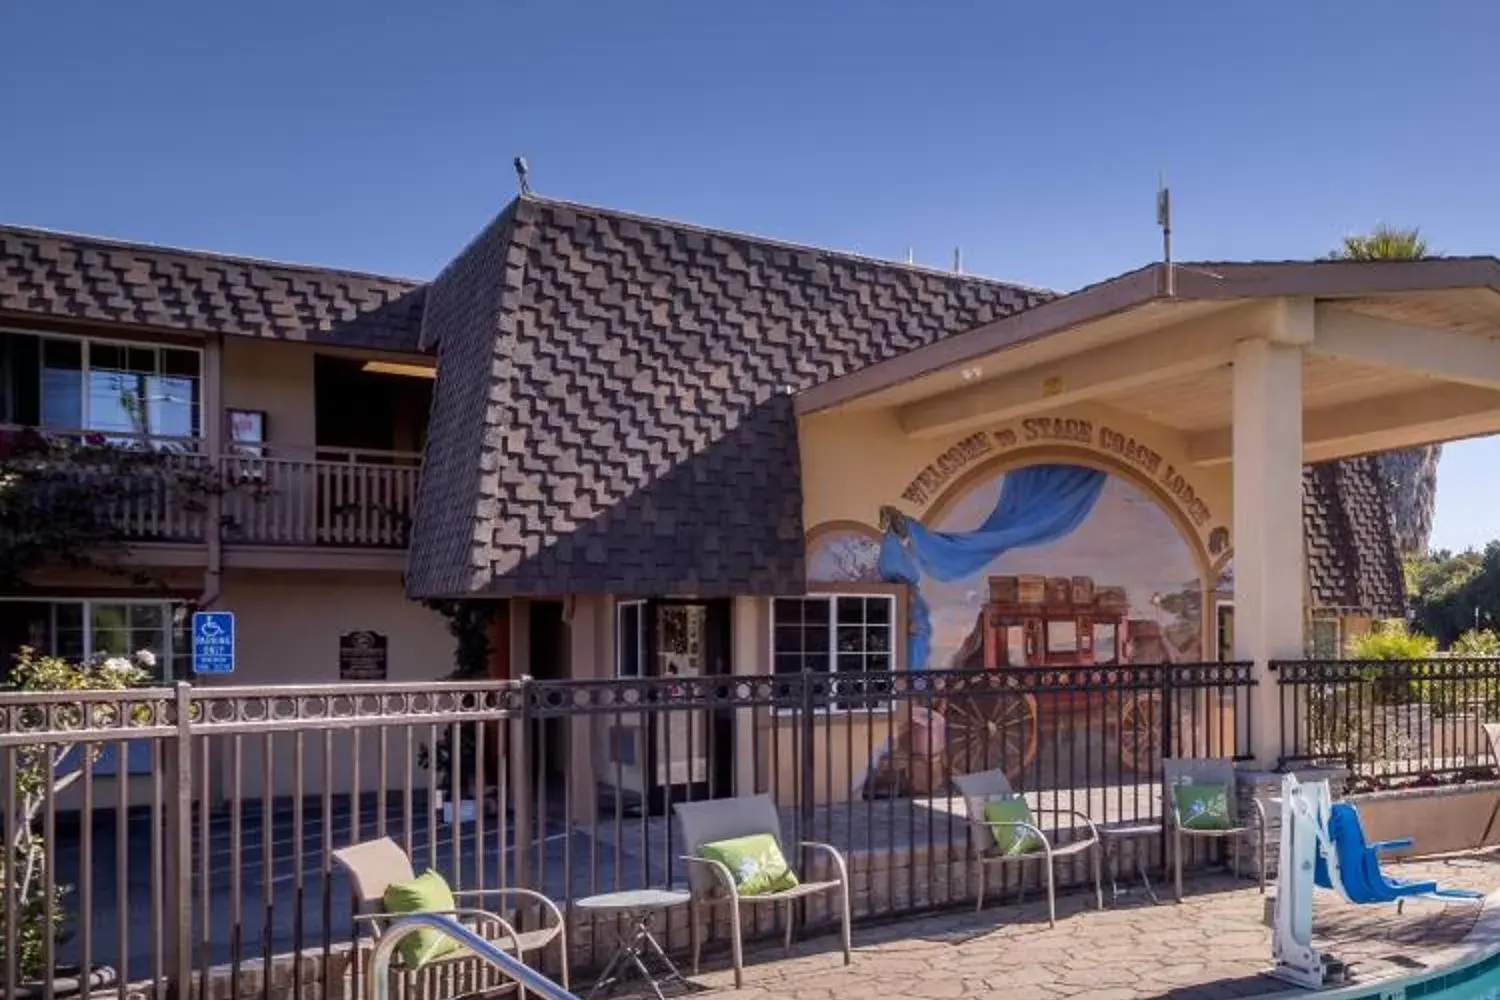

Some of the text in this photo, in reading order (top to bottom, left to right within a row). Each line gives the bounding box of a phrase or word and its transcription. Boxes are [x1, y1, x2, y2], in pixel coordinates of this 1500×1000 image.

[901, 431, 992, 505] WELCOME
[1022, 417, 1092, 443] STAGE
[1100, 426, 1162, 474] COACH
[1161, 464, 1211, 527] LODGE
